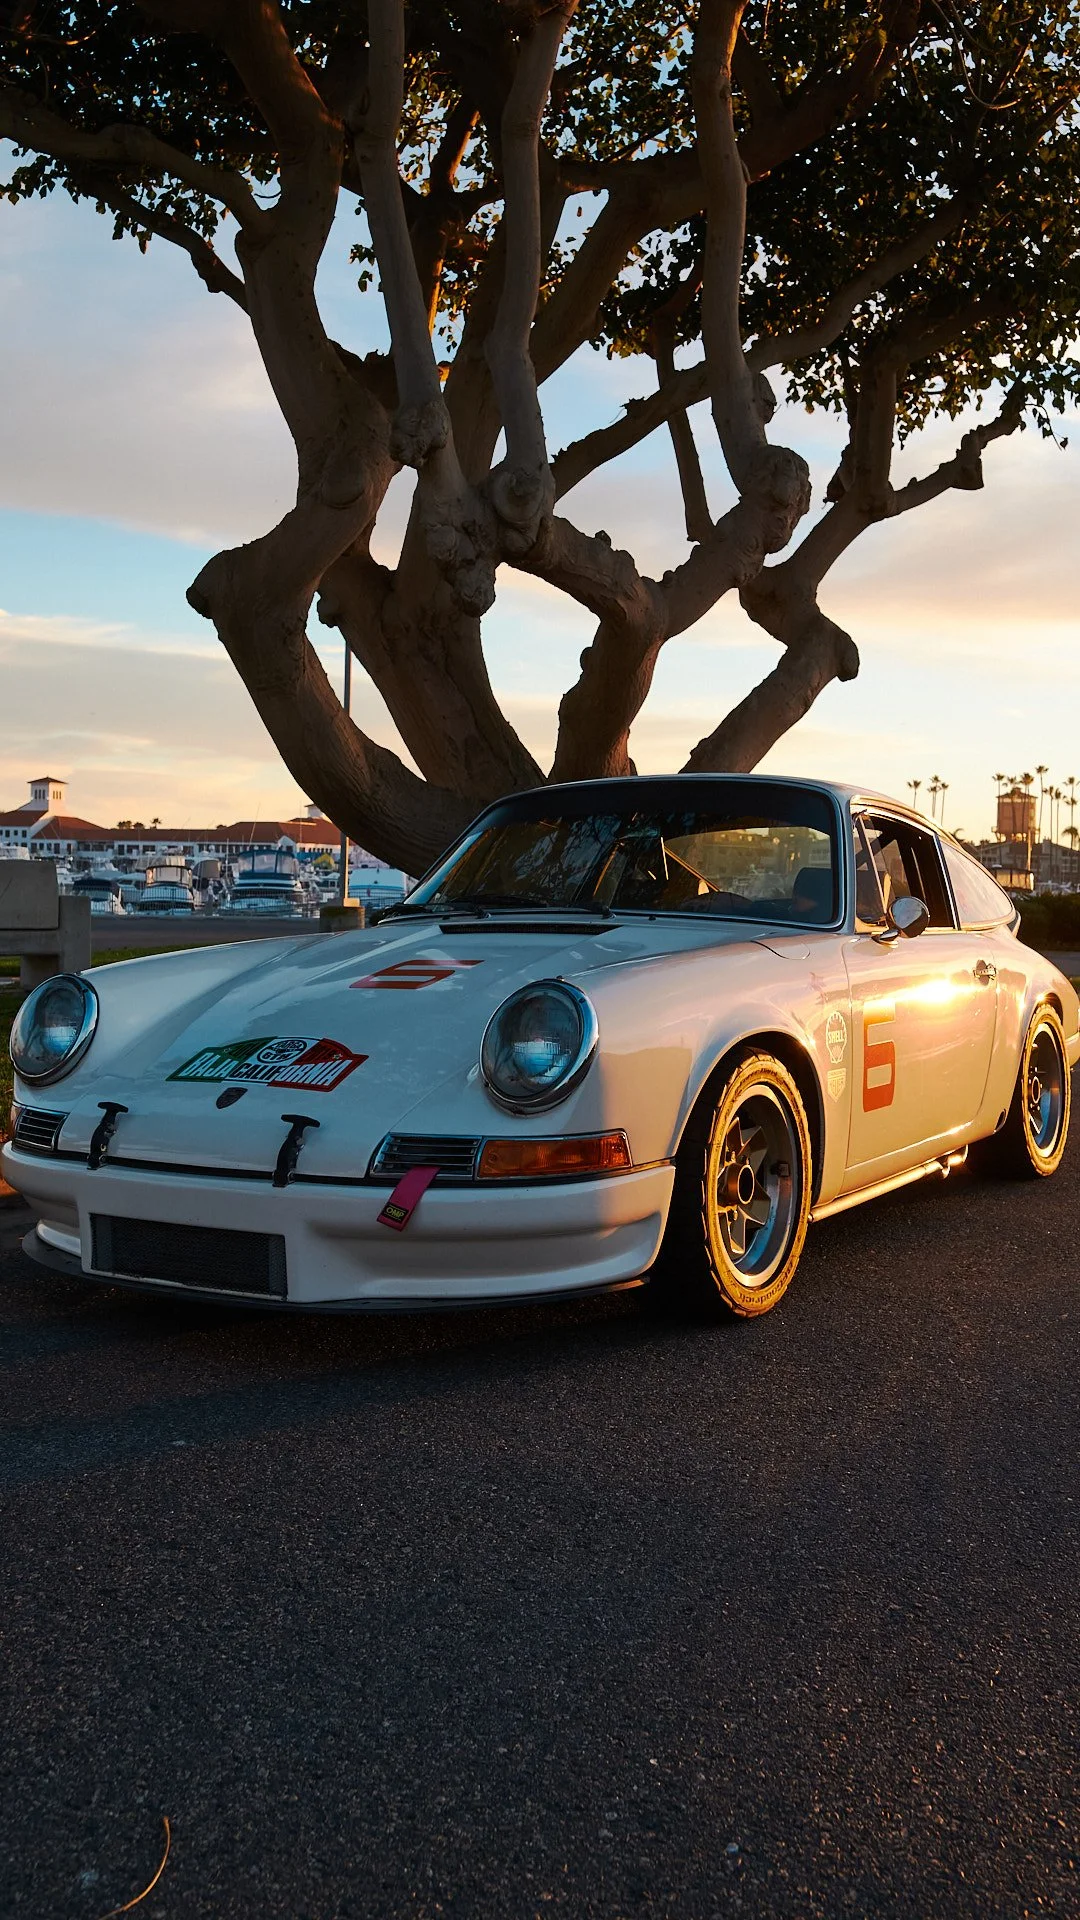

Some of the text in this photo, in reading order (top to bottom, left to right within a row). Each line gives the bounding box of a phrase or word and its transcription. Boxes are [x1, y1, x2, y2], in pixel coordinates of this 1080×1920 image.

[349, 959, 485, 990] 6
[828, 1029, 845, 1044] SHELL
[182, 1052, 352, 1086] BAJA CALIFORNIA
[862, 1001, 896, 1113] 6
[386, 1206, 405, 1218] OMP
[739, 1260, 794, 1305] BFGoodrich
